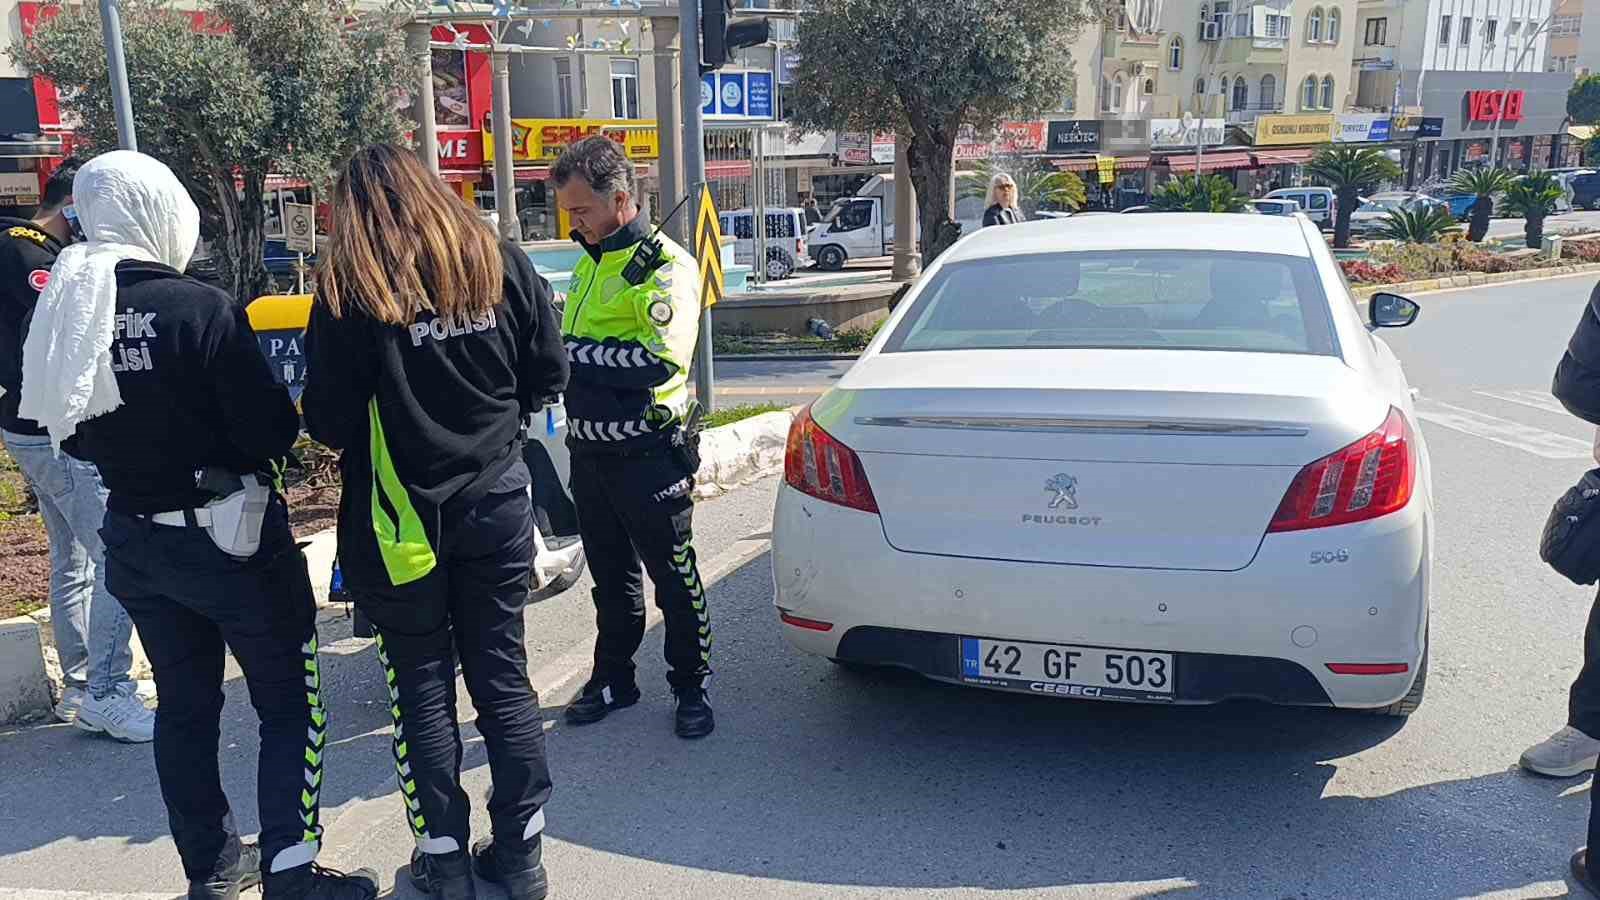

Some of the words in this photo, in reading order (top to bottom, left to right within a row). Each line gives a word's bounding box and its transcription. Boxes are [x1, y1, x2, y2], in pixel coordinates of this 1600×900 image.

[1470, 89, 1524, 121] VESEL
[1021, 513, 1103, 526] PEUGEOT
[1308, 547, 1350, 565] 508
[984, 645, 1022, 676] 42
[1043, 648, 1082, 680] GF
[1105, 654, 1167, 688] 503
